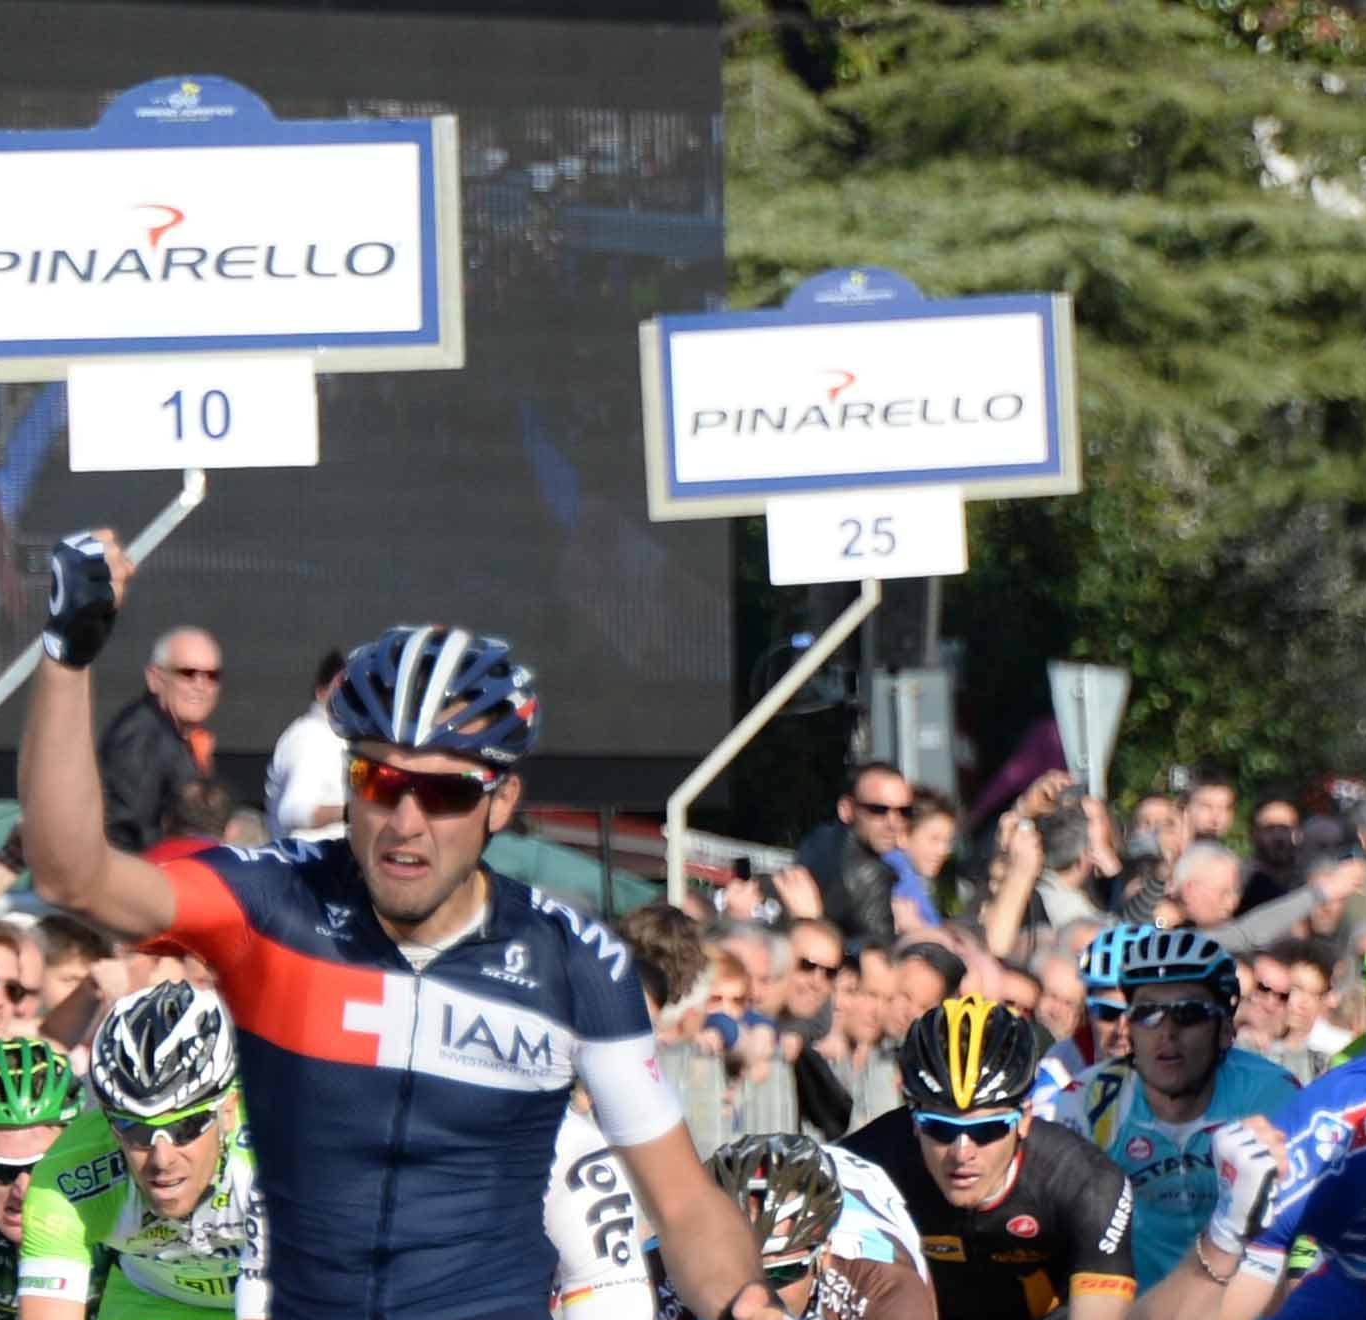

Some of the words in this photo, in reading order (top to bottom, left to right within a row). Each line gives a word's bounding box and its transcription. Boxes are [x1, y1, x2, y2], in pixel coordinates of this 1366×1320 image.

[161, 389, 232, 442] 10
[691, 392, 1026, 438] PINARELLO
[838, 516, 897, 560] 25
[480, 967, 541, 990] SCOTT
[440, 1003, 554, 1067] IAM
[565, 1147, 634, 1268] lotto
